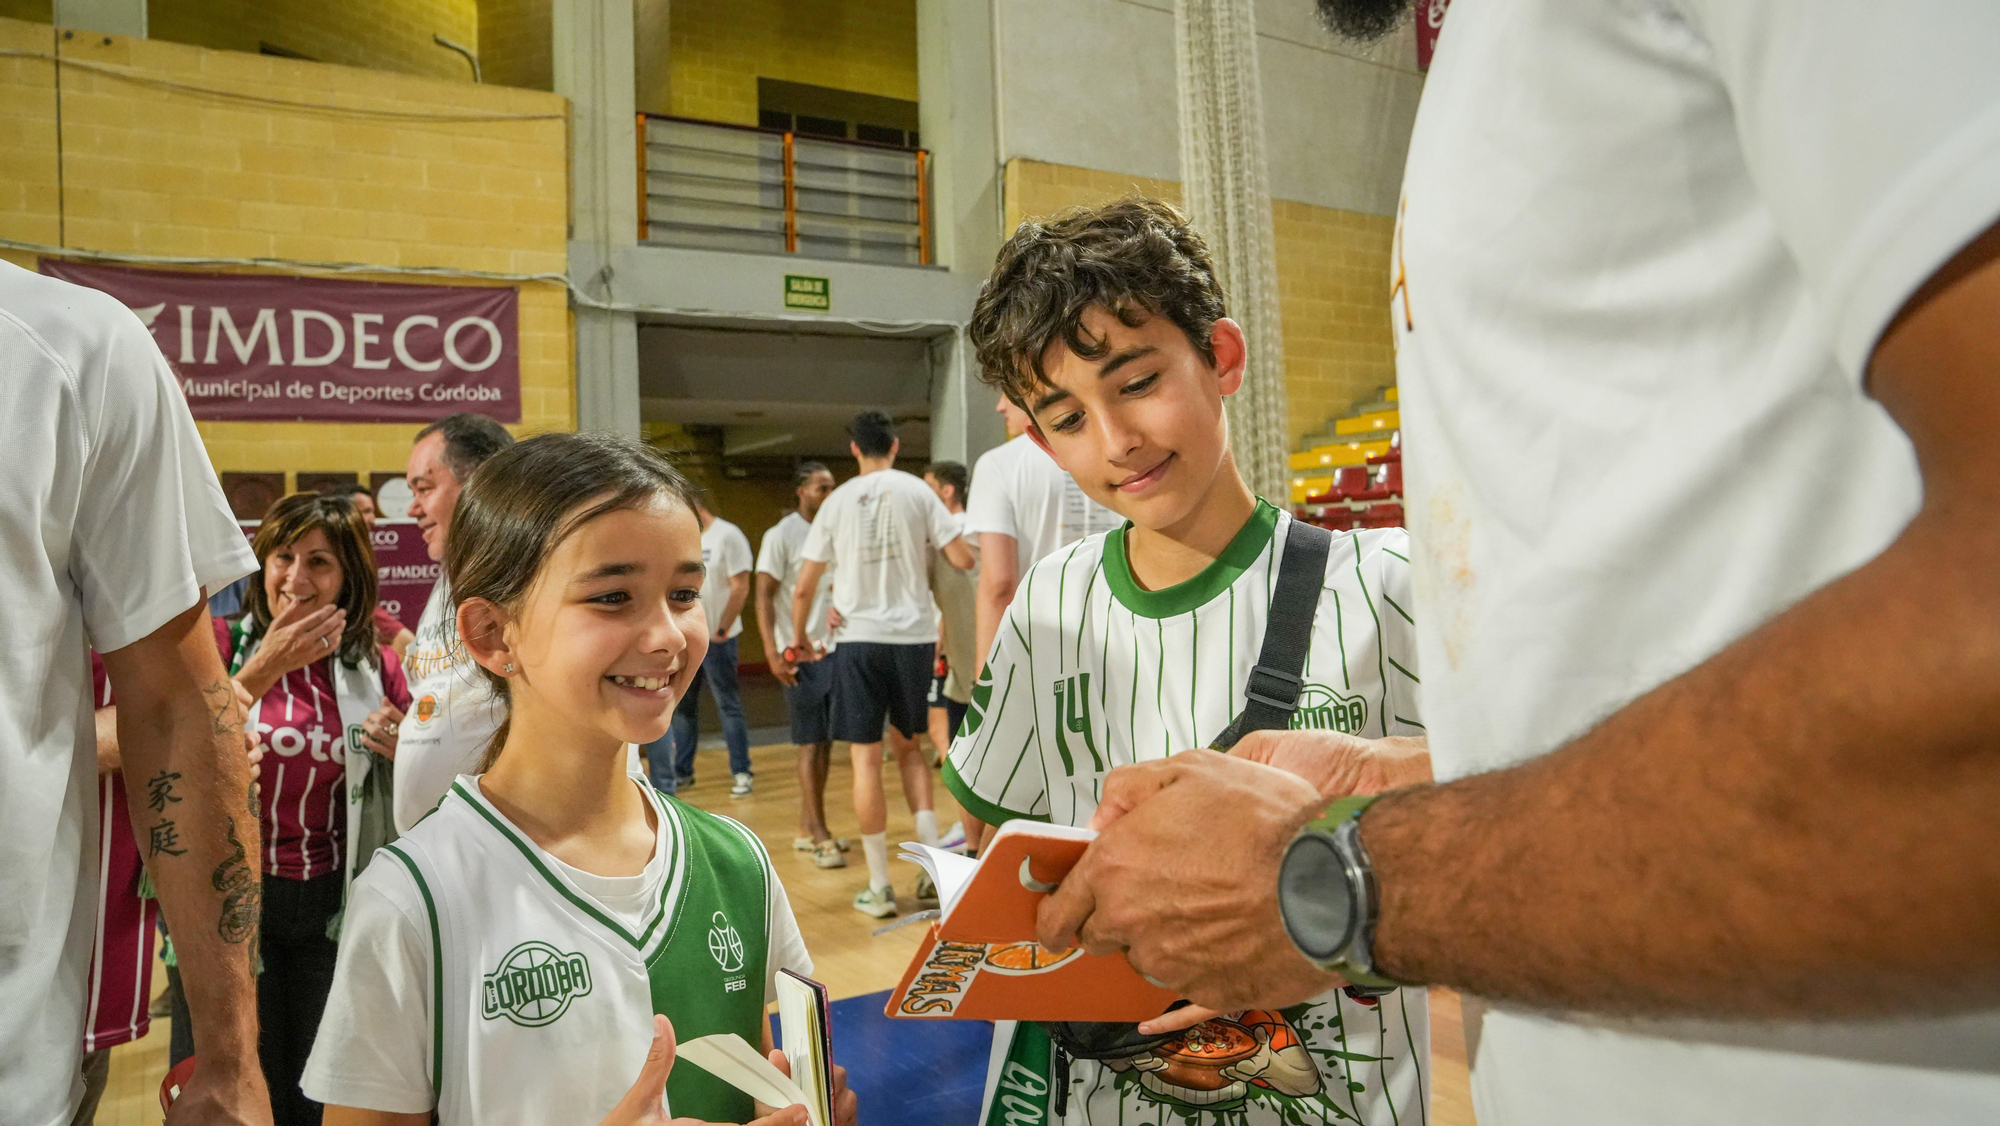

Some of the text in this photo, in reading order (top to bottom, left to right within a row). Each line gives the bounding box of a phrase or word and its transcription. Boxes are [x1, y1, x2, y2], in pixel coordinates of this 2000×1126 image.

[176, 304, 503, 373] IMDECO
[183, 377, 502, 404] Municipal de Deportes Córdoba
[1054, 672, 1104, 777] 14
[148, 770, 188, 859] 家庭
[484, 958, 587, 1014] CORDOBA
[724, 979, 747, 993] FEB
